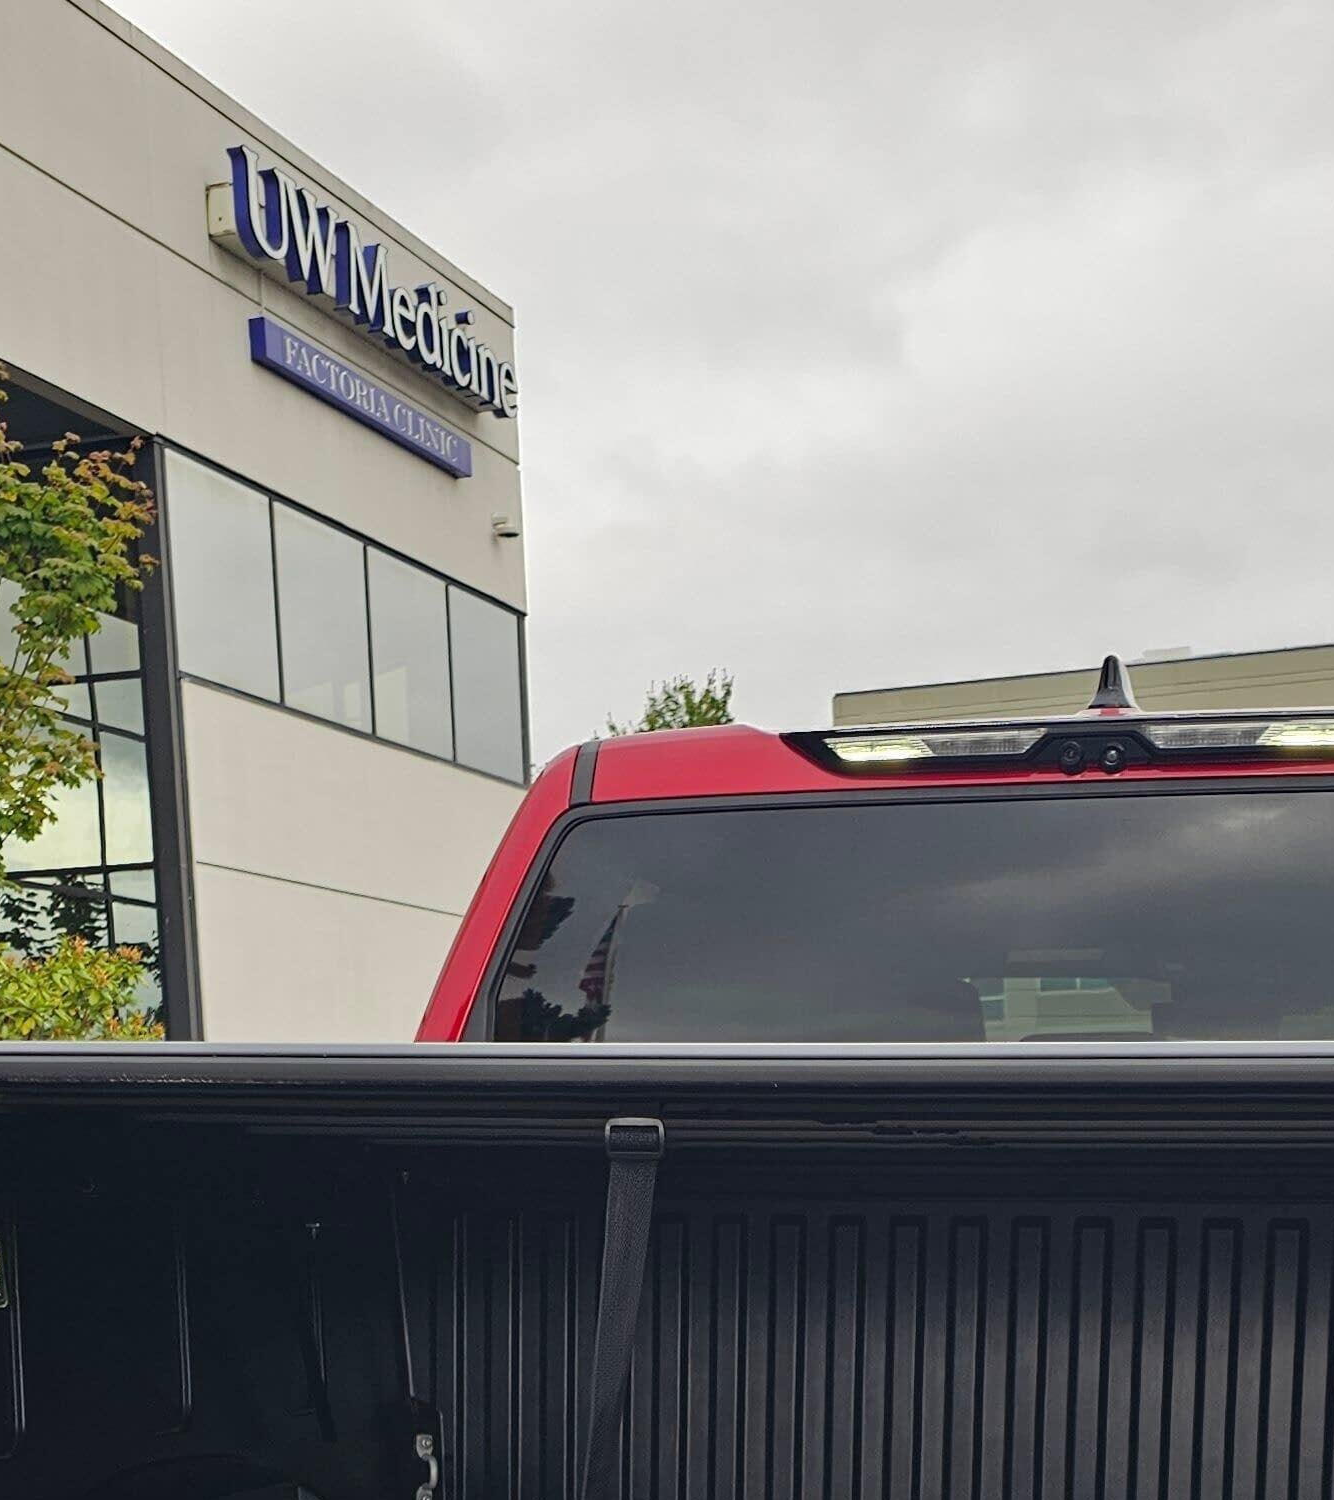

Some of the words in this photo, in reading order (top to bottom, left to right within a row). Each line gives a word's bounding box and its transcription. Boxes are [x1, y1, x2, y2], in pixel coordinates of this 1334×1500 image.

[227, 145, 340, 297] UW
[335, 220, 518, 419] Medicine
[283, 335, 391, 422] FACTORIA
[393, 403, 459, 462] CLINIC
